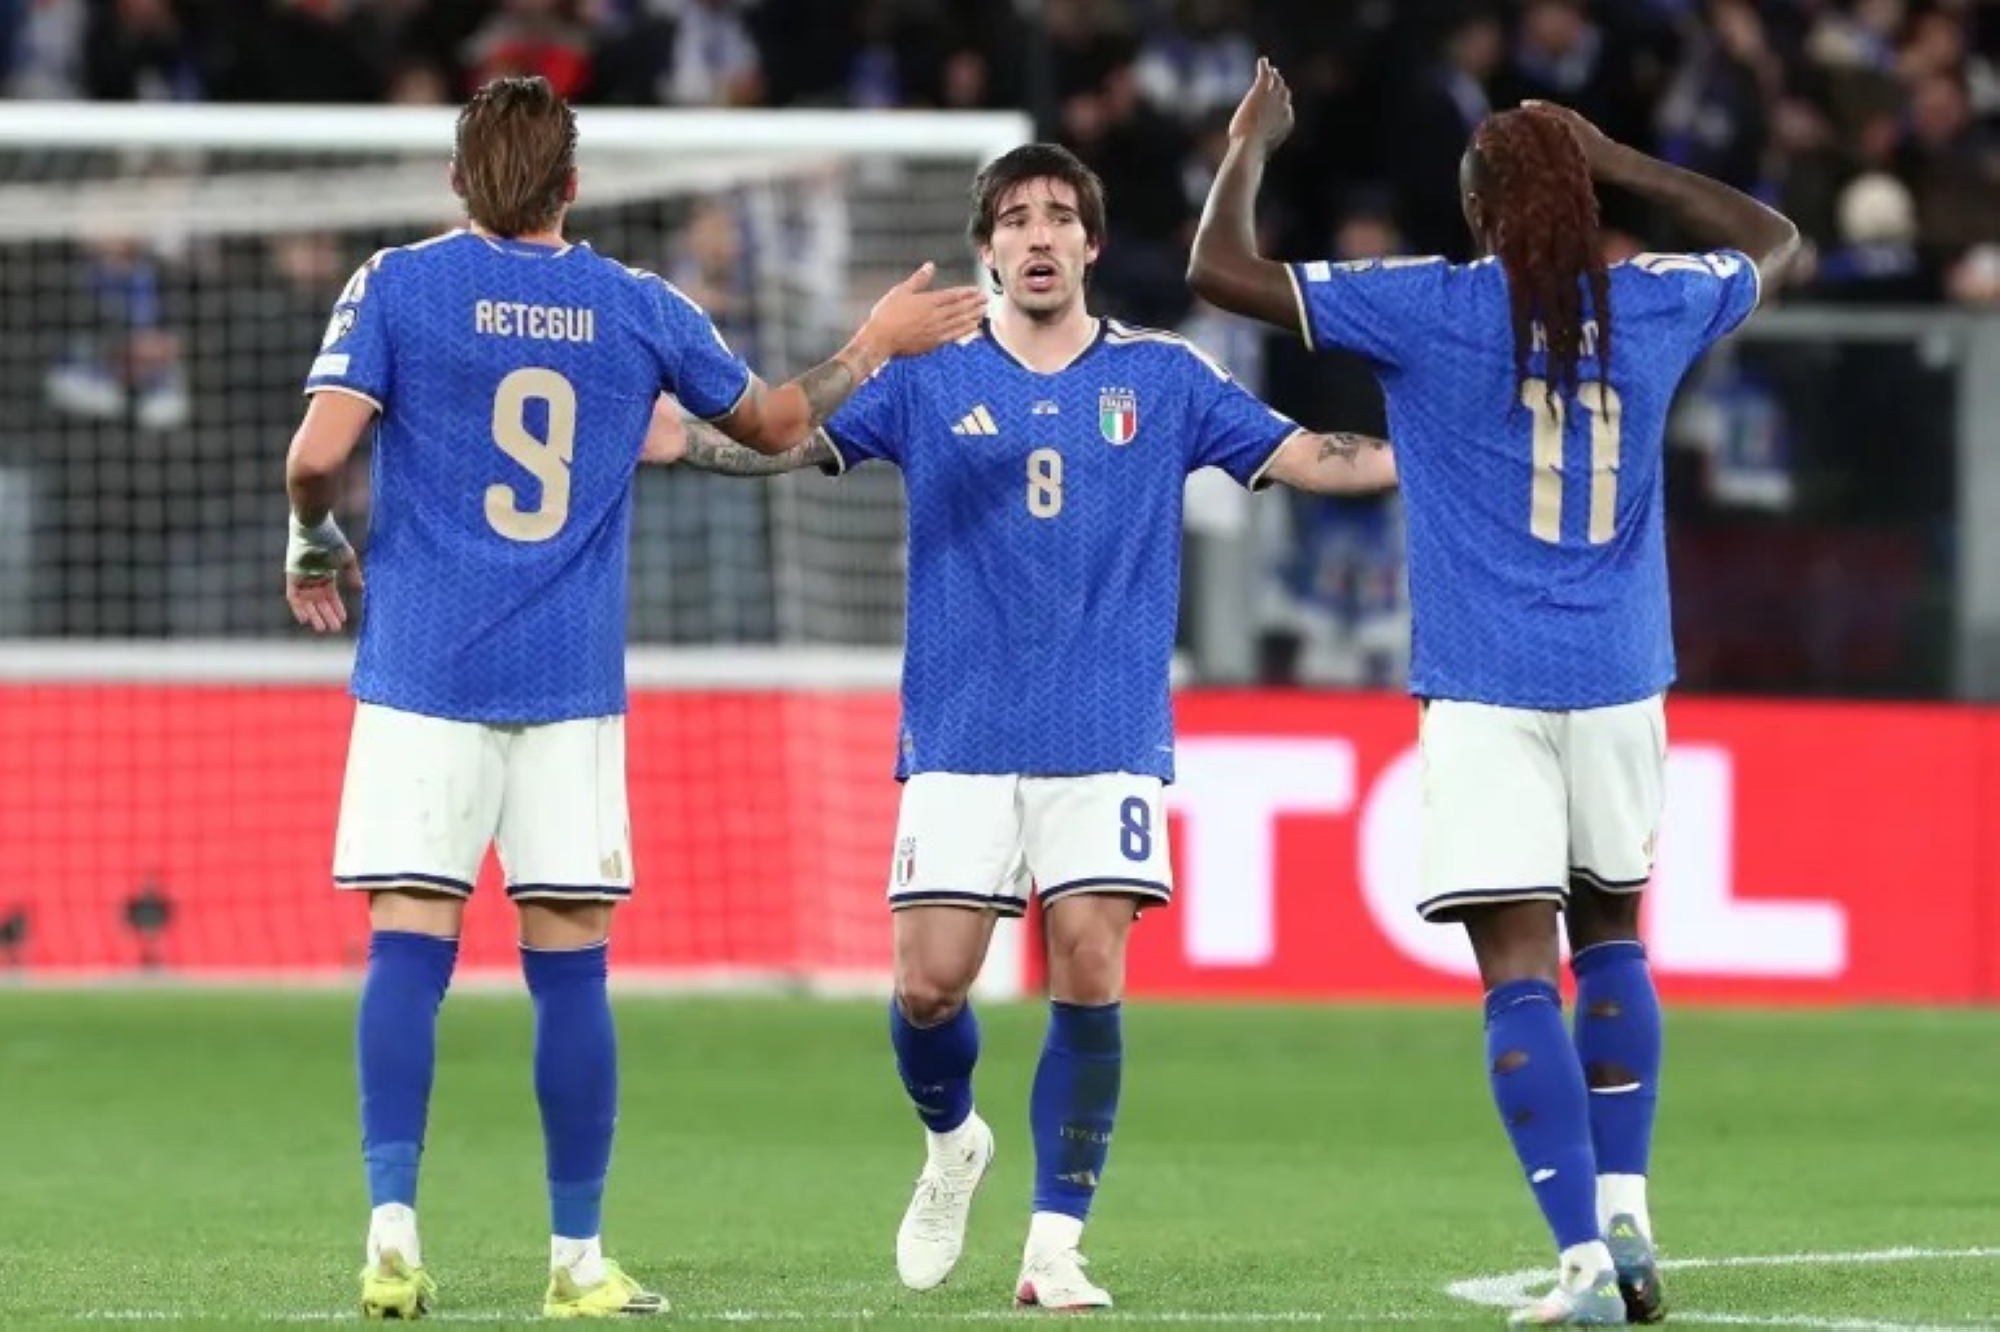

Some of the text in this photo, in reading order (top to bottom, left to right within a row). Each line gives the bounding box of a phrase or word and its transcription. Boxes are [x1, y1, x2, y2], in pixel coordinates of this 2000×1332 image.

[475, 299, 594, 343] RETEGUI
[485, 367, 577, 542] 9
[1027, 448, 1063, 518] 8
[1521, 379, 1622, 544] 11
[1120, 796, 1152, 862] 8
